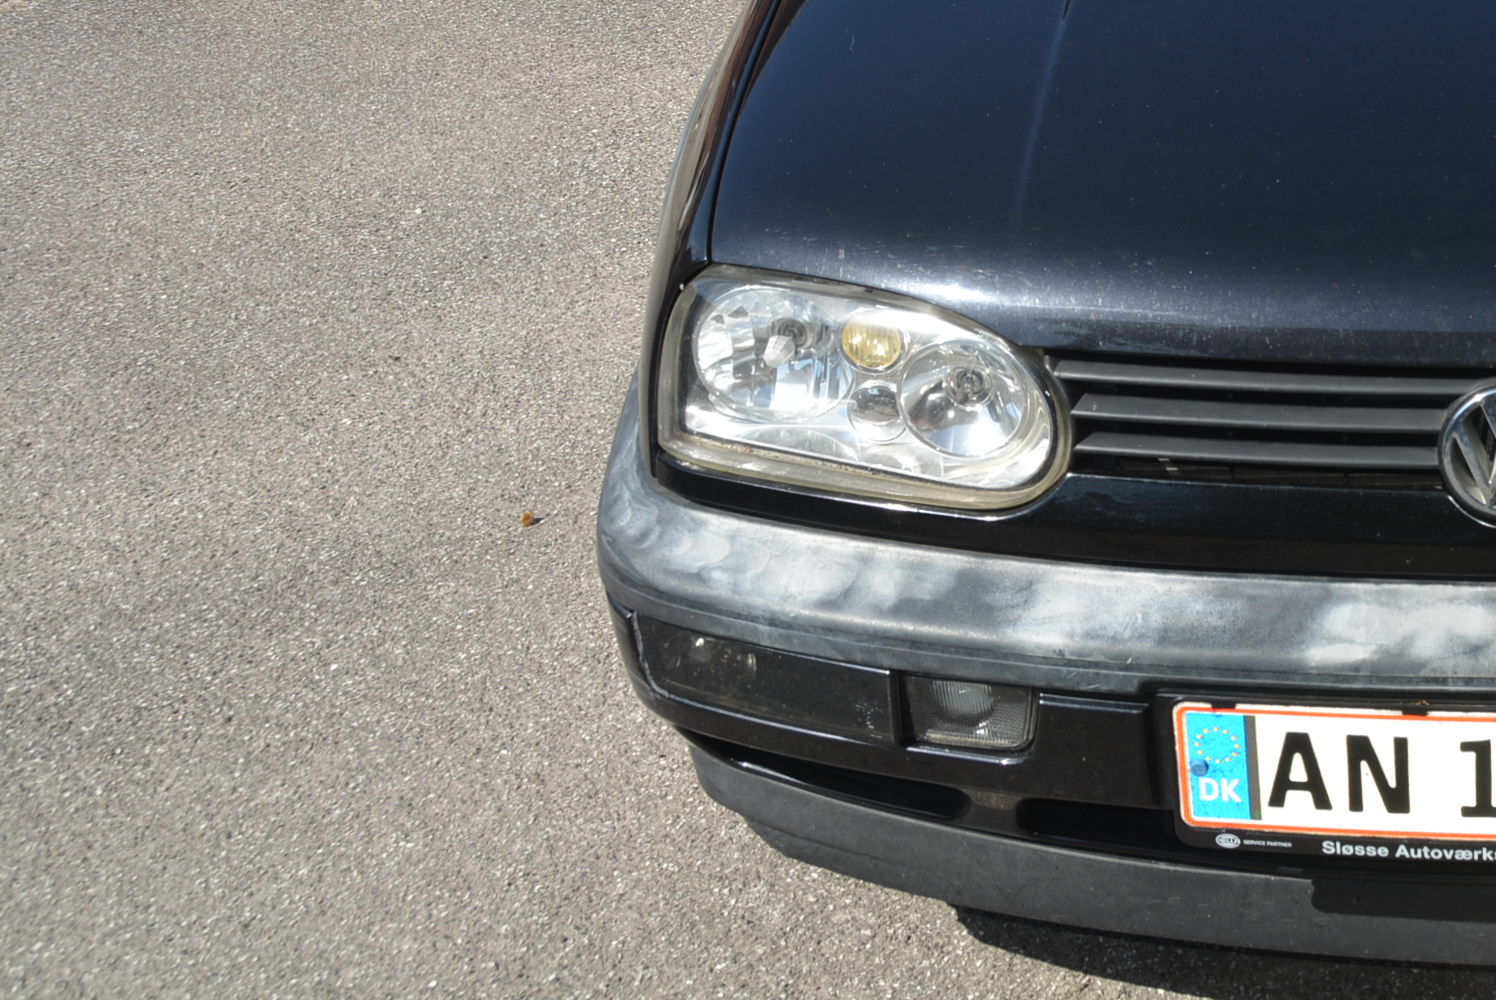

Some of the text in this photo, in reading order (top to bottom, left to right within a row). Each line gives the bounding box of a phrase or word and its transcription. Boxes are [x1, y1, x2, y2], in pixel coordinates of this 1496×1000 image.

[1268, 731, 1411, 815] AN
[1200, 777, 1241, 803] DK
[1321, 840, 1390, 858] Sløsse
